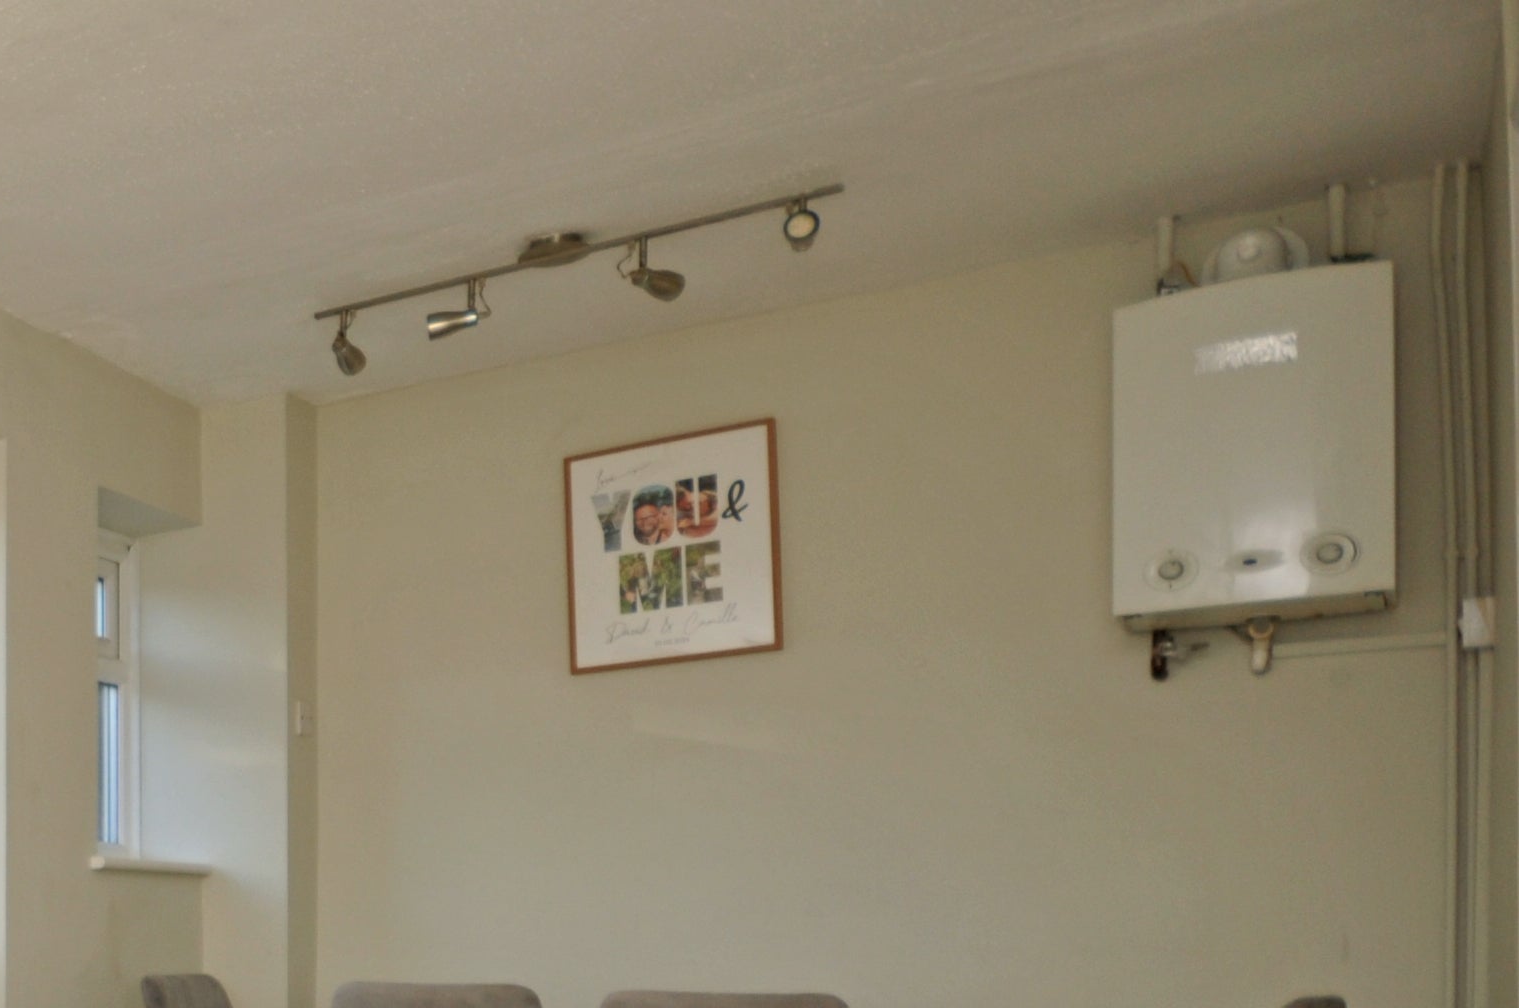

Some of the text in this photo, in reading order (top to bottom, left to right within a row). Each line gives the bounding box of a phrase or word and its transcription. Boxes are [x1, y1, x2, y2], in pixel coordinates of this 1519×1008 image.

[590, 474, 718, 552] YOU
[722, 479, 749, 522] &
[619, 540, 724, 614] ME
